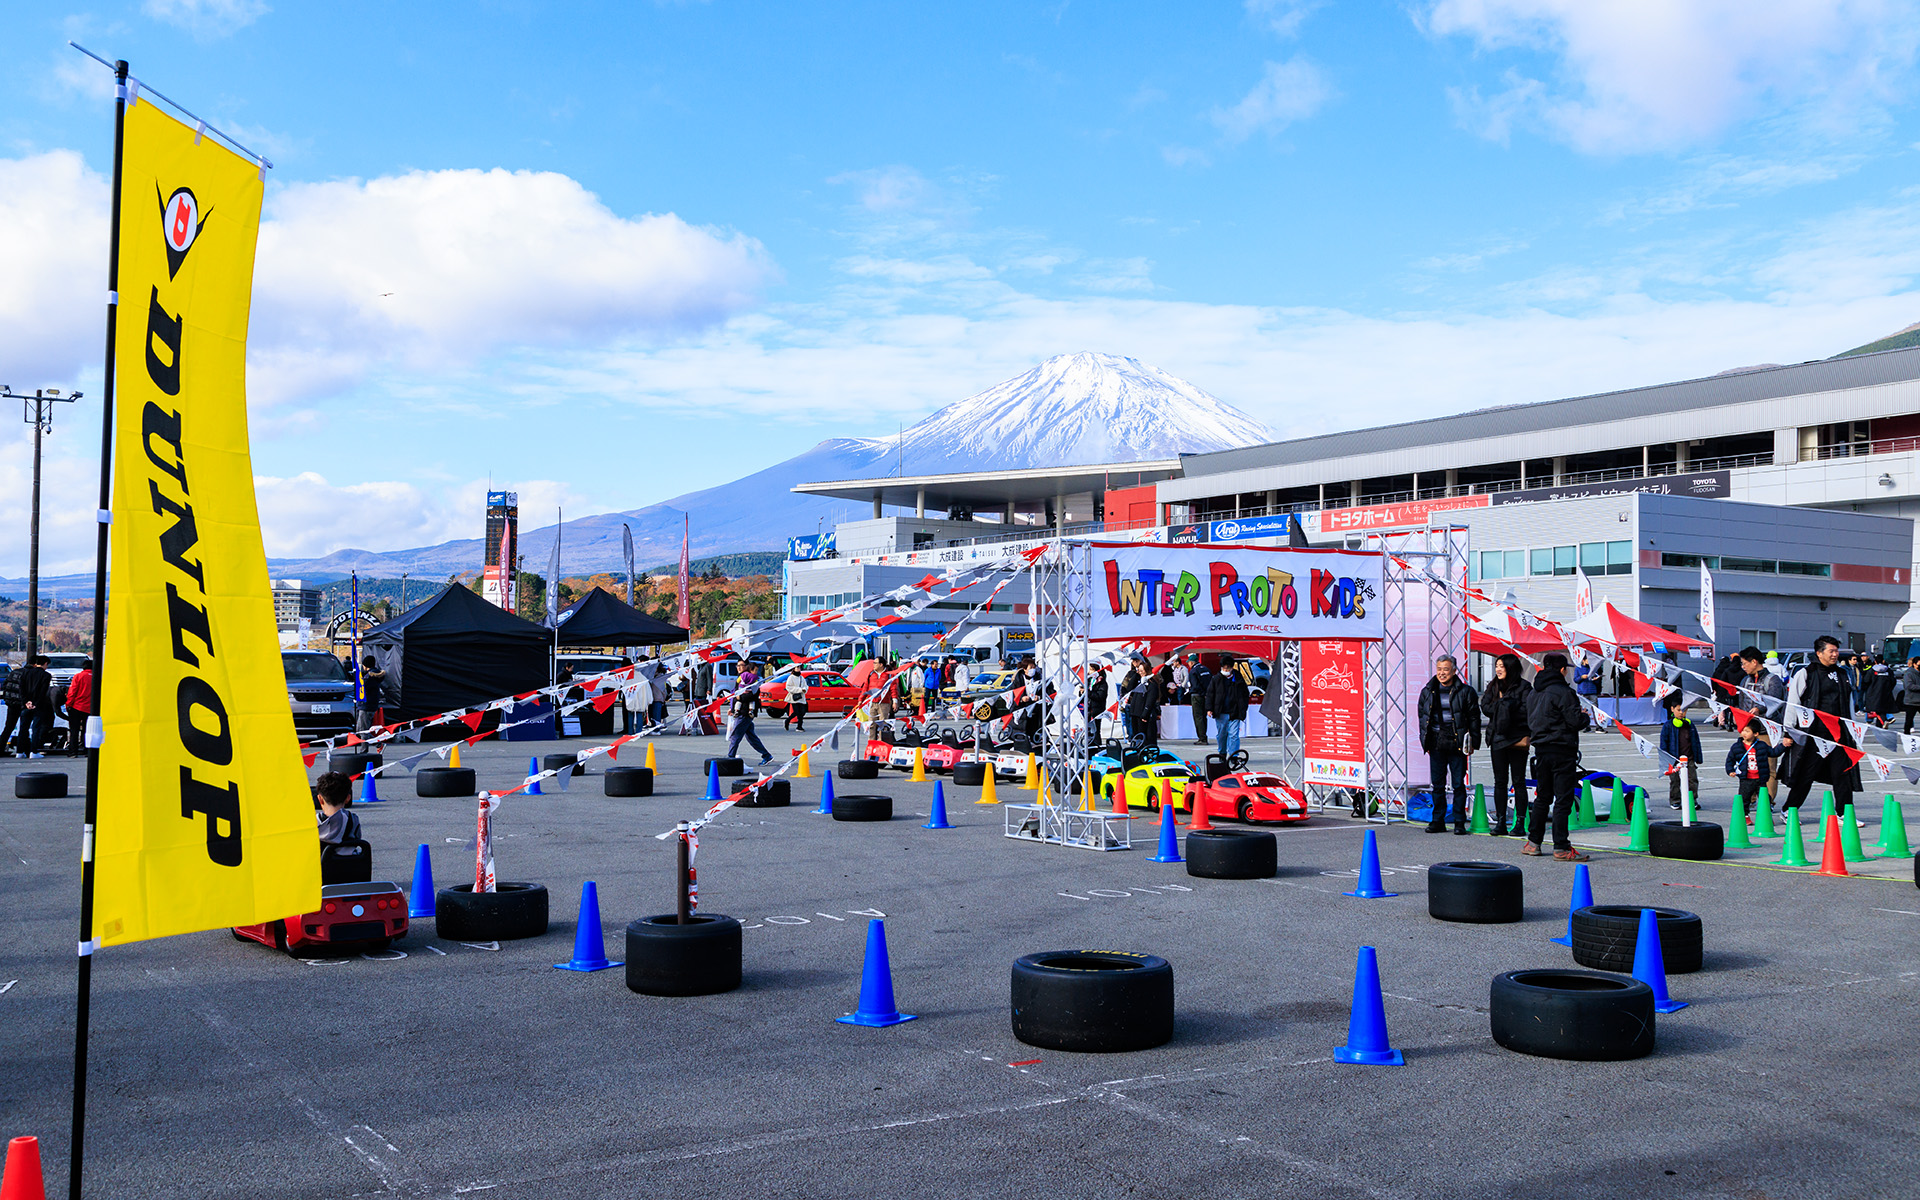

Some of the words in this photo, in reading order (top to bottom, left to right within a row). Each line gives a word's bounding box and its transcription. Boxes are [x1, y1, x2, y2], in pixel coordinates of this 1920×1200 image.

[1331, 508, 1395, 528] トヨタホーム
[1241, 524, 1256, 533] Racing
[939, 550, 964, 563] 大成建設
[142, 283, 243, 868] DUNLOP
[1893, 569, 1900, 584] 4
[1103, 559, 1201, 618] INTER
[1209, 561, 1297, 619] PROTO
[1210, 623, 1242, 633] DRIVING
[1243, 623, 1281, 634] ATHLETE
[1007, 632, 1034, 640] H+R
[1246, 778, 1259, 786] 44
[1080, 949, 1149, 959] PIRELLI
